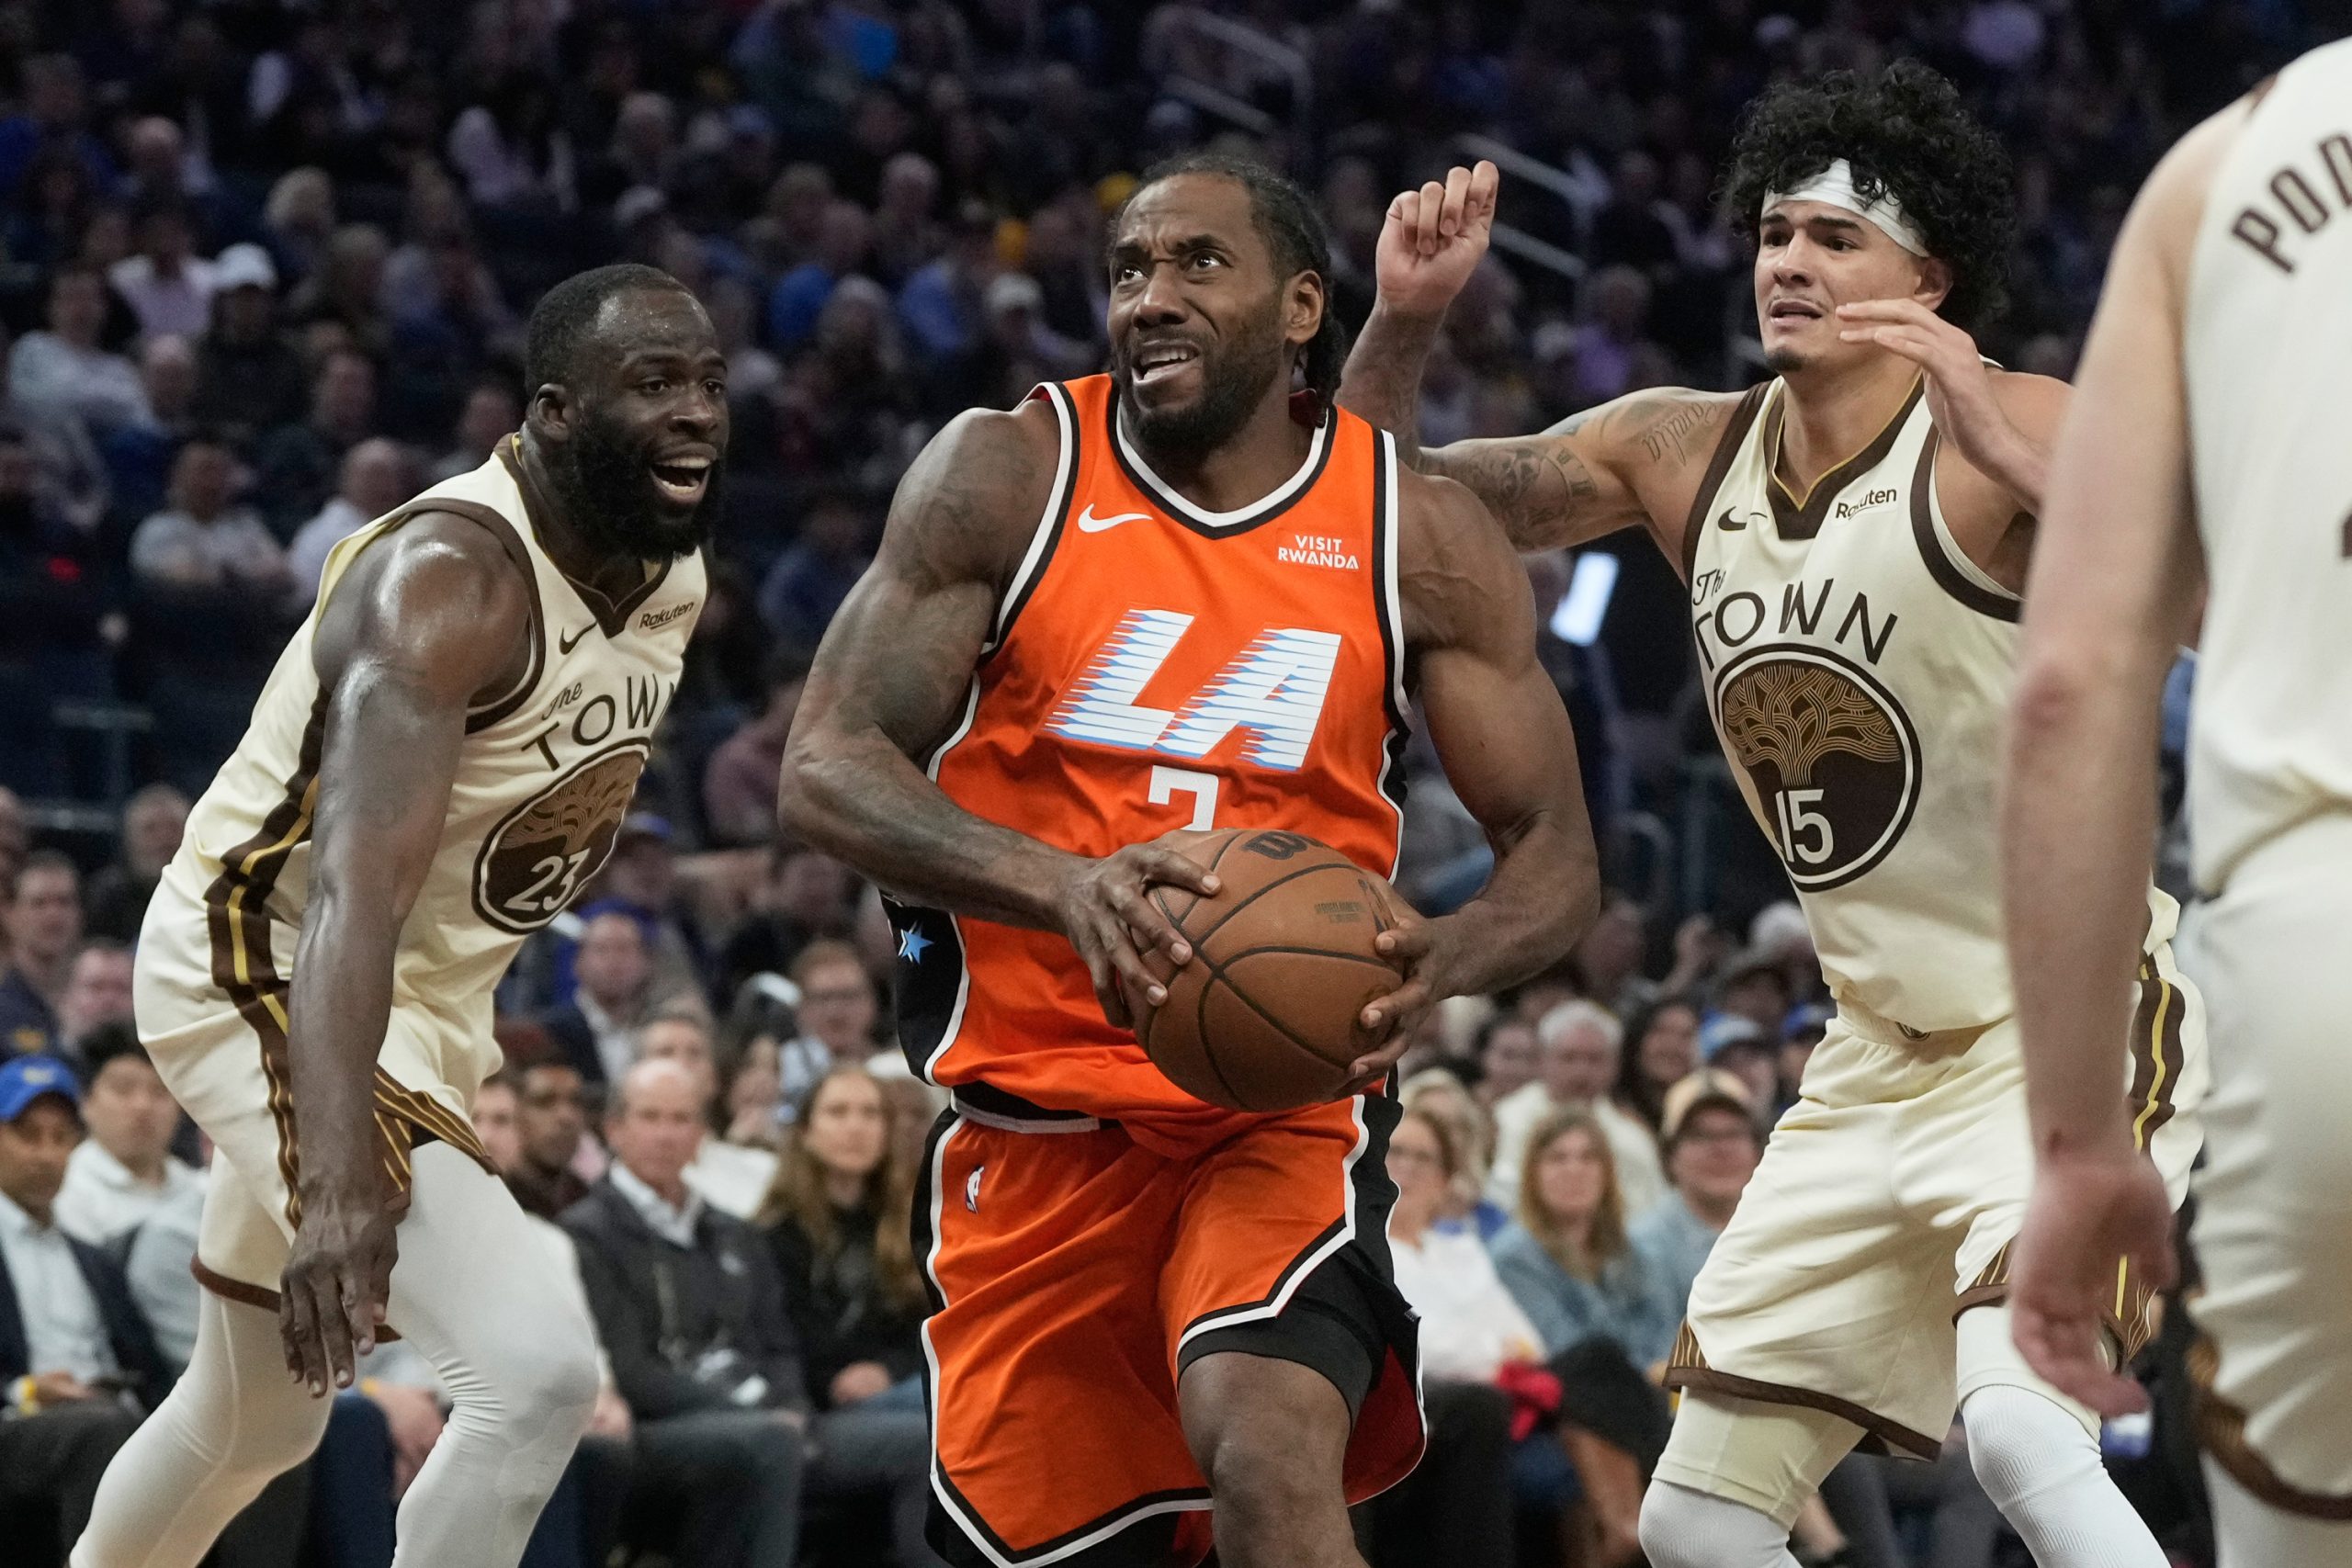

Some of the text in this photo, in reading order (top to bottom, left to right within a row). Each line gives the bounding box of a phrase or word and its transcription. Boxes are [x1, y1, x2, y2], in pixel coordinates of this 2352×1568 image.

[1835, 488, 1897, 520] Rauten
[1278, 547, 1359, 570] RWANDA
[1295, 535, 1342, 553] VISIT
[639, 601, 695, 629] Rakuten
[1694, 578, 1898, 672] TOWN
[521, 673, 675, 772] TOW
[1042, 608, 1342, 772] LA
[1774, 787, 1835, 864] 15
[503, 847, 591, 912] 23
